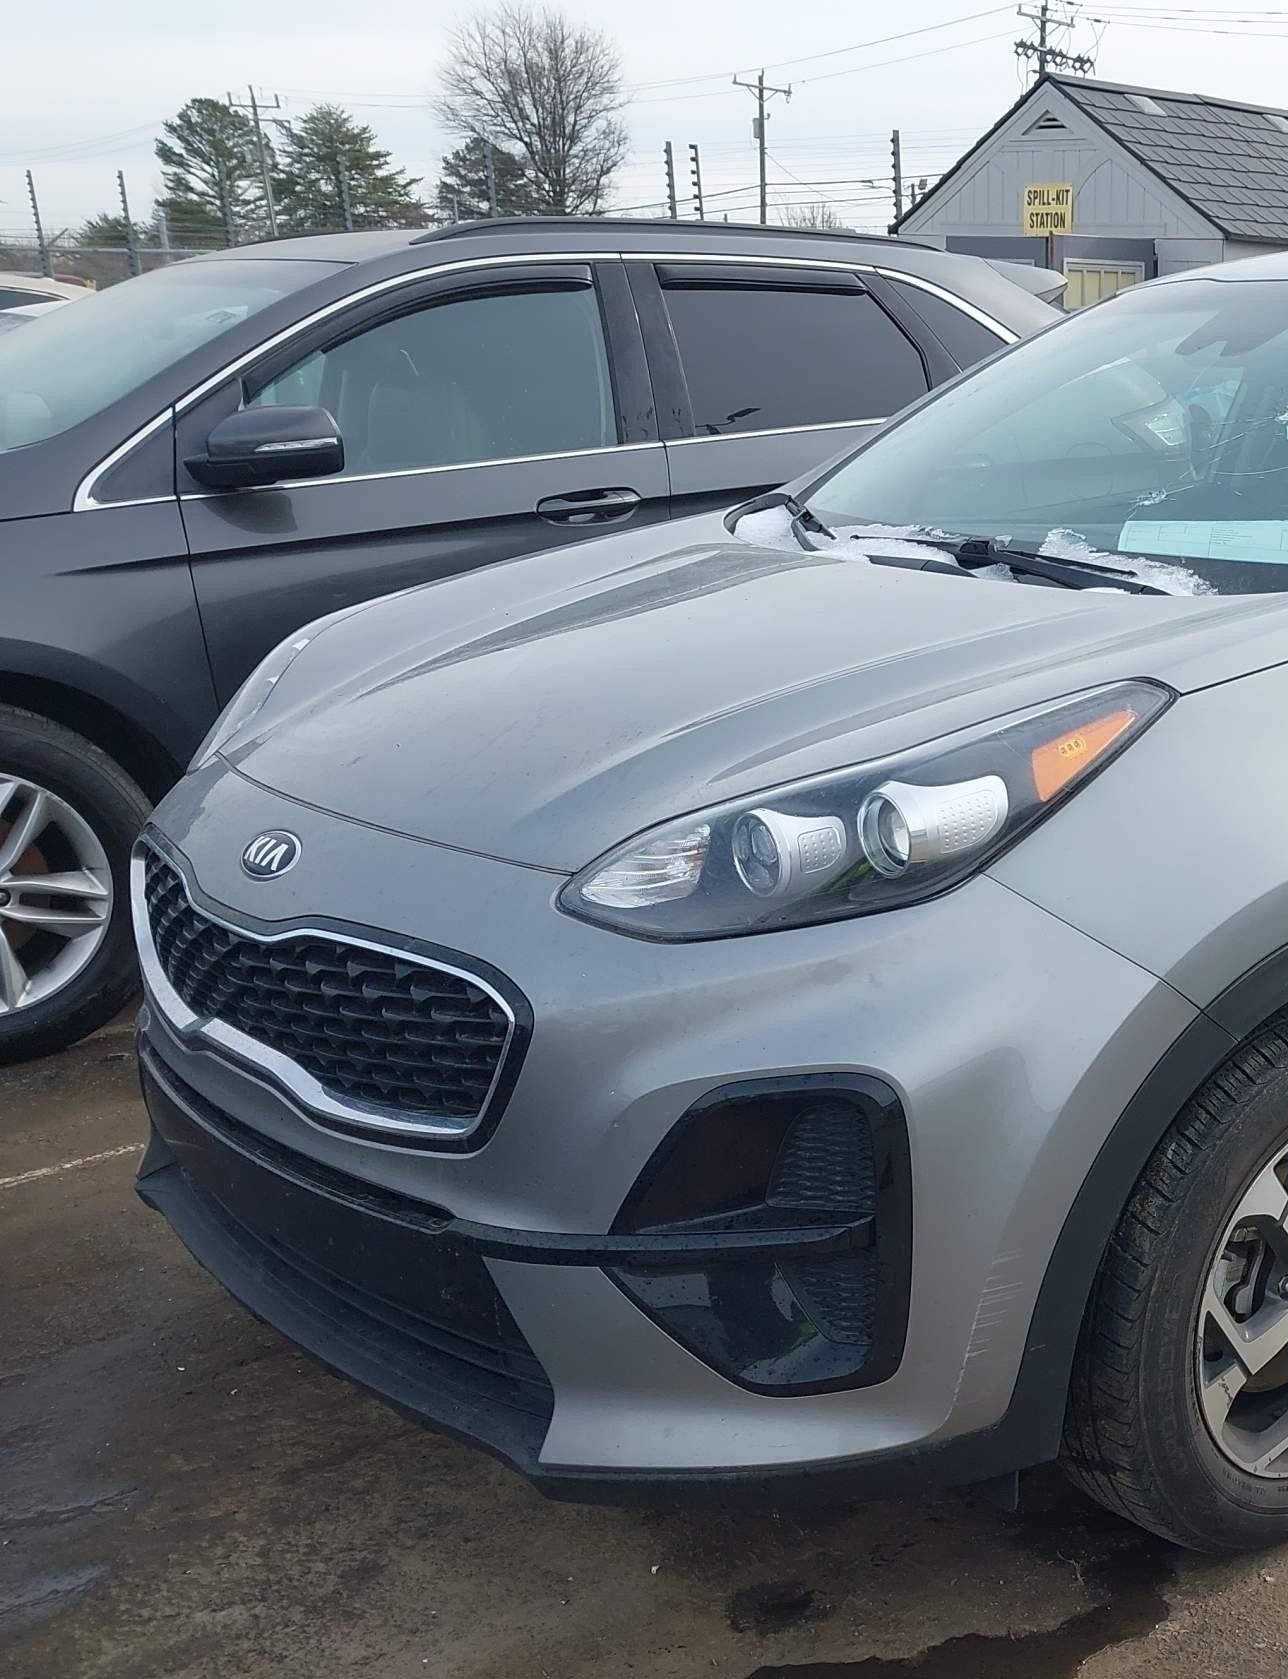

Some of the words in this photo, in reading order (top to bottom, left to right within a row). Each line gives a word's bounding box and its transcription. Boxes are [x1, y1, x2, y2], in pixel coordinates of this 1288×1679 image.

[1026, 189, 1070, 206] SPILL-KIT
[1029, 212, 1066, 229] STATION
[243, 836, 289, 871] KIA
